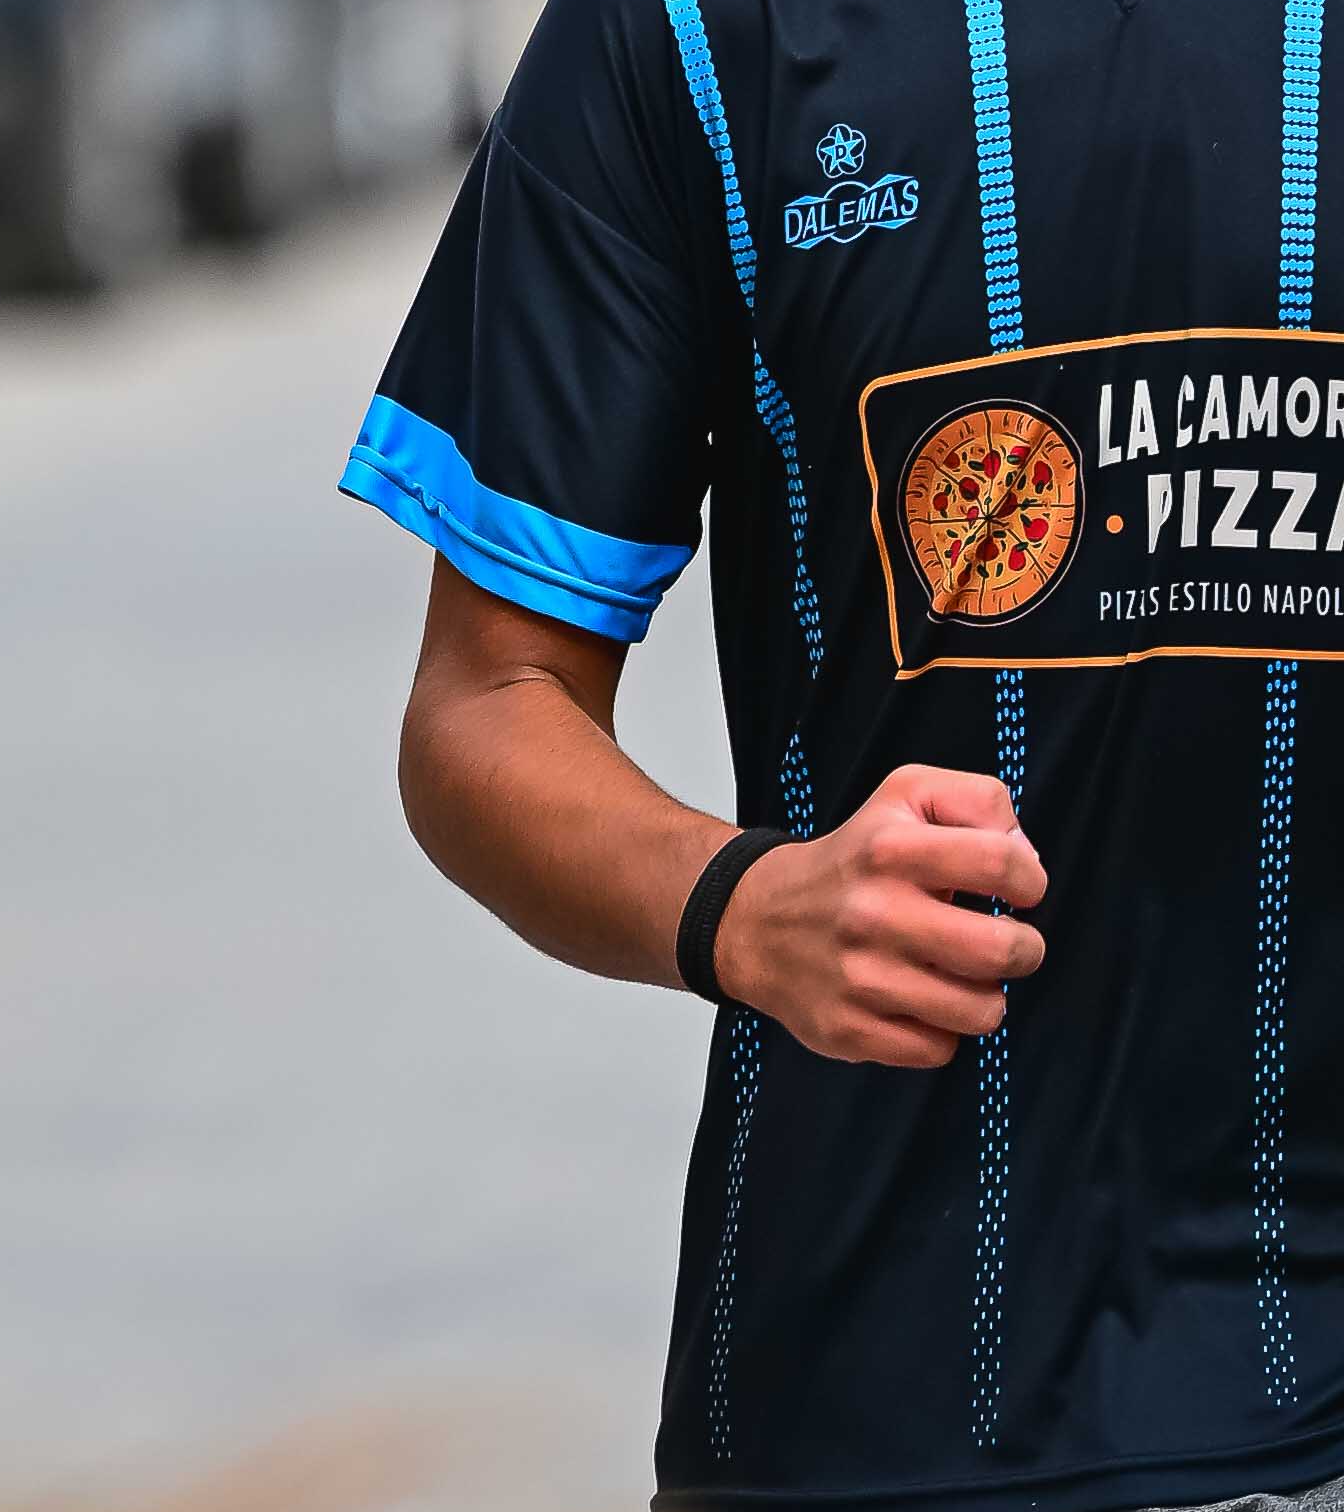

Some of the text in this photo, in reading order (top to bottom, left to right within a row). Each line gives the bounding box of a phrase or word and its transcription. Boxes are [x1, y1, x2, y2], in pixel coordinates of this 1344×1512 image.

[784, 179, 920, 244] DALEMAS
[1098, 378, 1160, 468] LA
[1169, 581, 1252, 613] ESTILO
